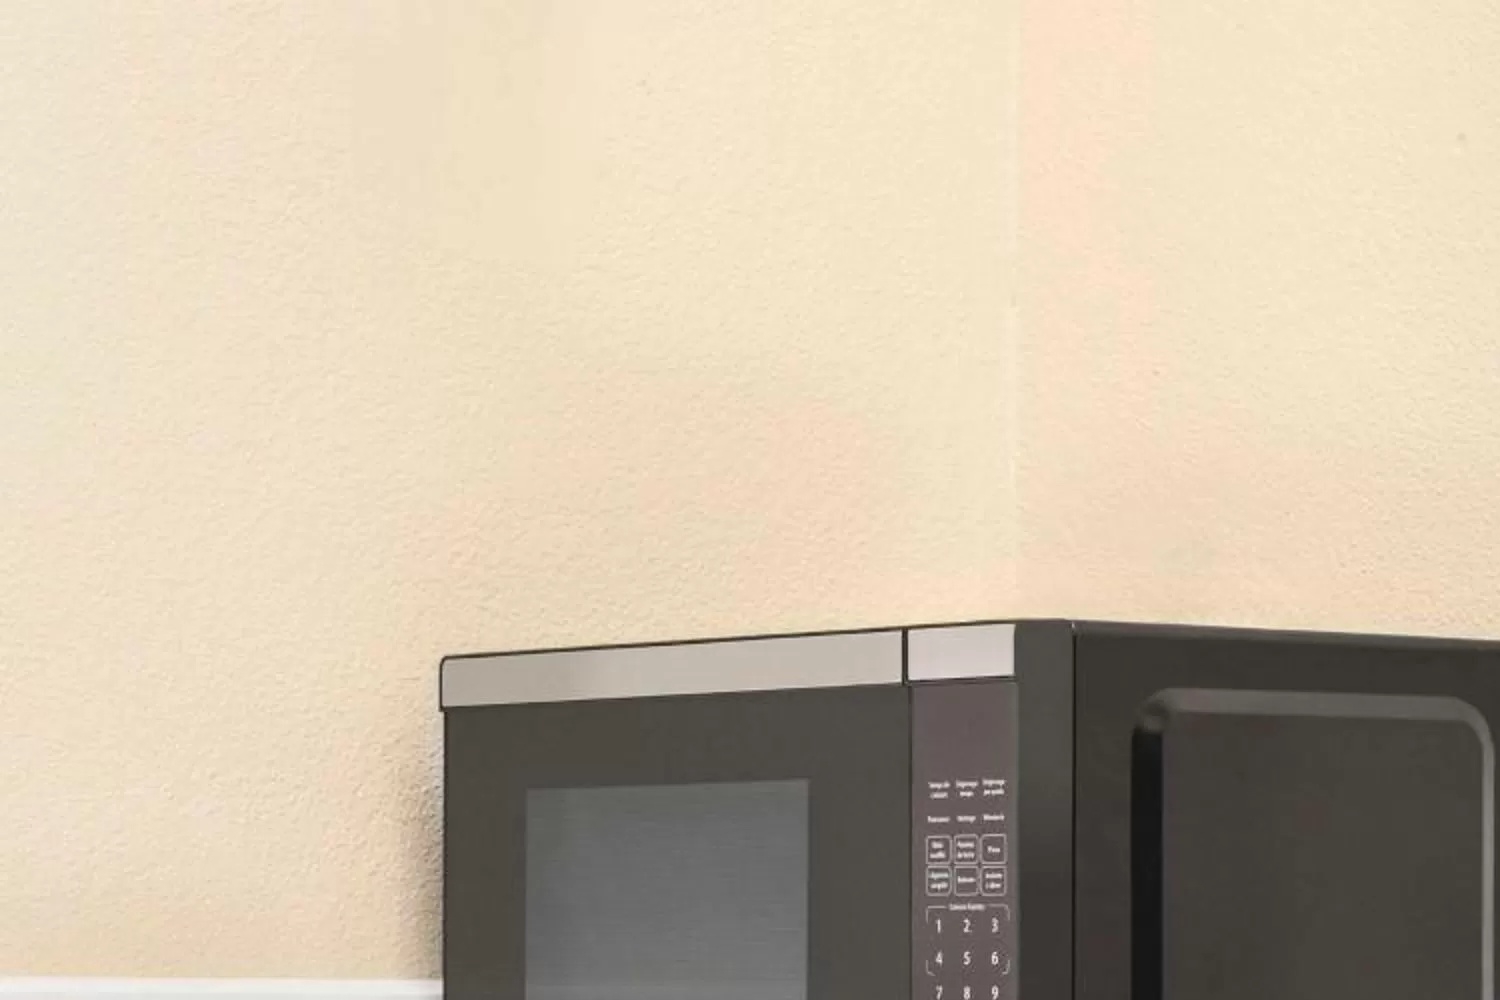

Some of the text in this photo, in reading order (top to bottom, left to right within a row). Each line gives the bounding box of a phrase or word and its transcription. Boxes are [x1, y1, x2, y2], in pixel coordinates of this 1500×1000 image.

[935, 917, 999, 933] 1 2 3
[935, 951, 999, 966] 4 5 6
[935, 985, 999, 1000] 7 8 9
